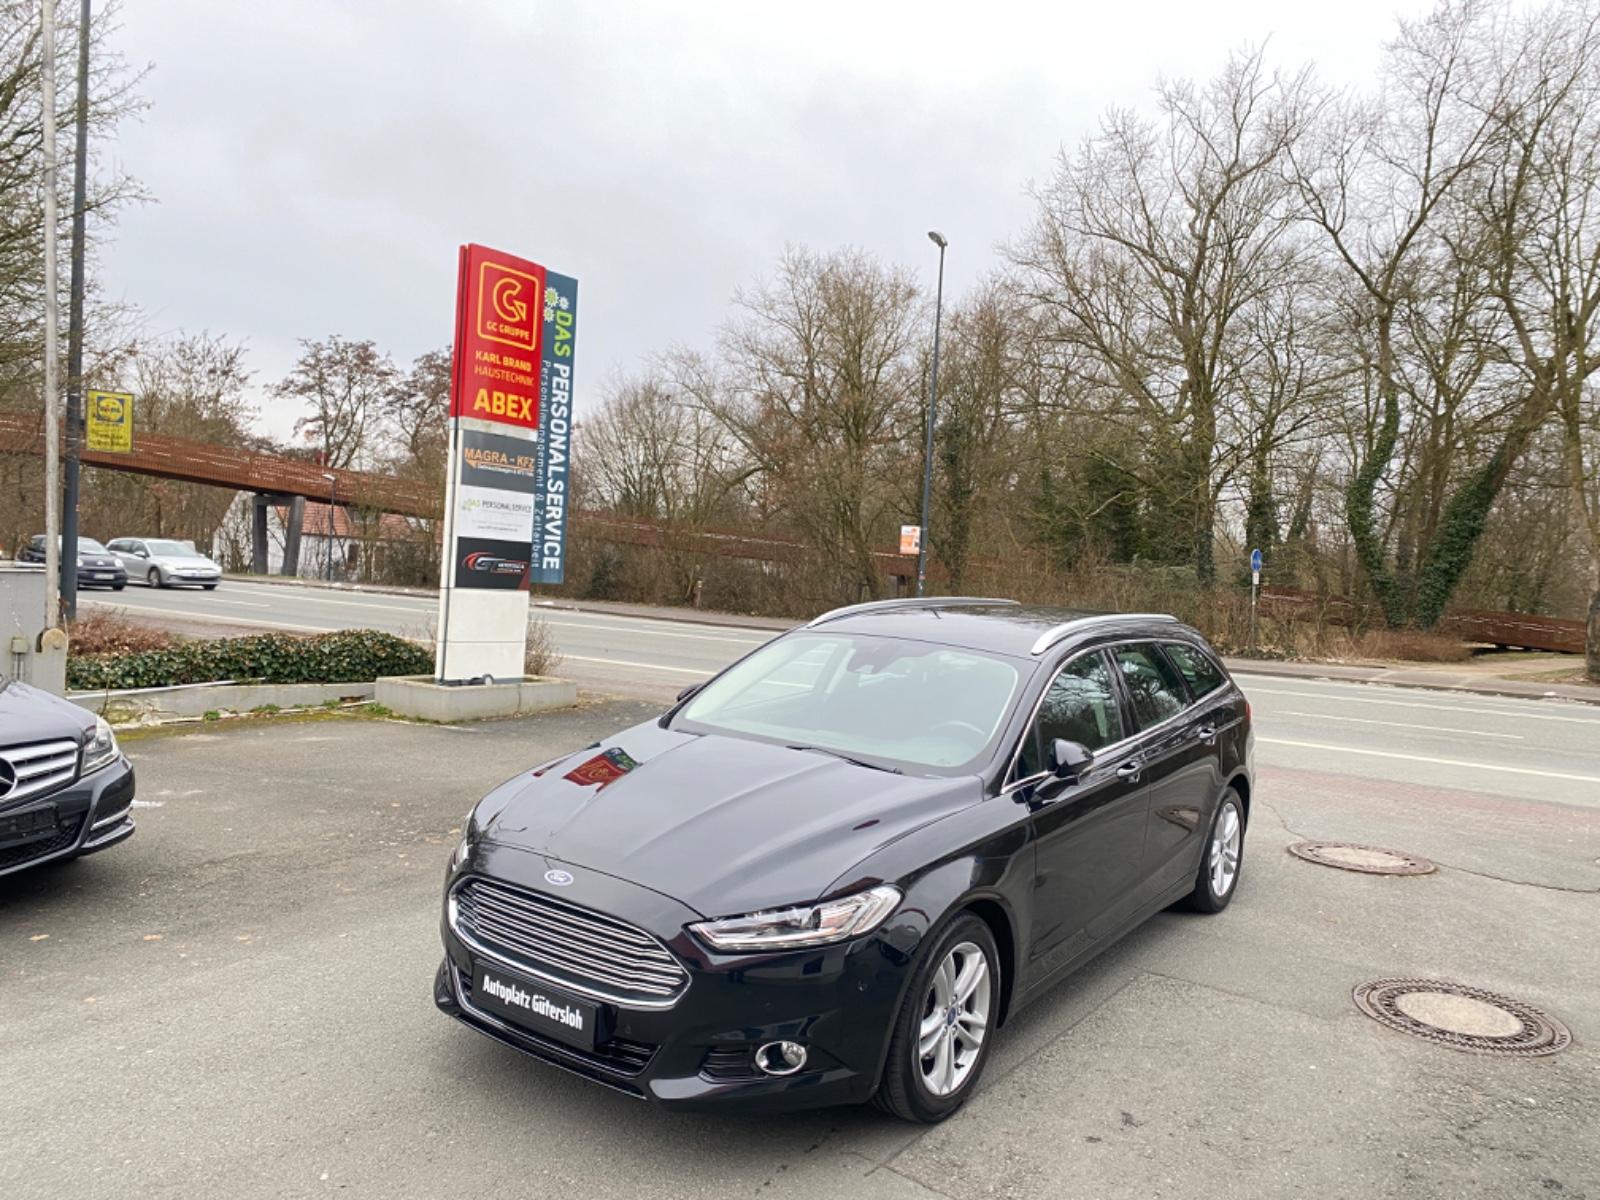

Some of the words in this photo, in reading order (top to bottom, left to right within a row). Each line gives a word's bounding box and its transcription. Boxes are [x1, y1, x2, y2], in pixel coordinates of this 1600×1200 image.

[499, 324, 530, 341] GRUPPE
[553, 310, 573, 358] DAS
[474, 365, 534, 386] HAUSTECHNIK
[475, 350, 501, 364] KARL
[502, 356, 532, 372] BRAND
[473, 388, 533, 422] ABEX
[535, 360, 552, 488] Personalmanagement
[464, 447, 508, 465] MAGRA
[516, 455, 536, 468] KFZ
[542, 362, 571, 570] PERSONALSERVICE
[530, 508, 544, 568] Zeitarbeit
[482, 975, 531, 1009] Autoplatz
[531, 994, 583, 1030] Gütersloh
